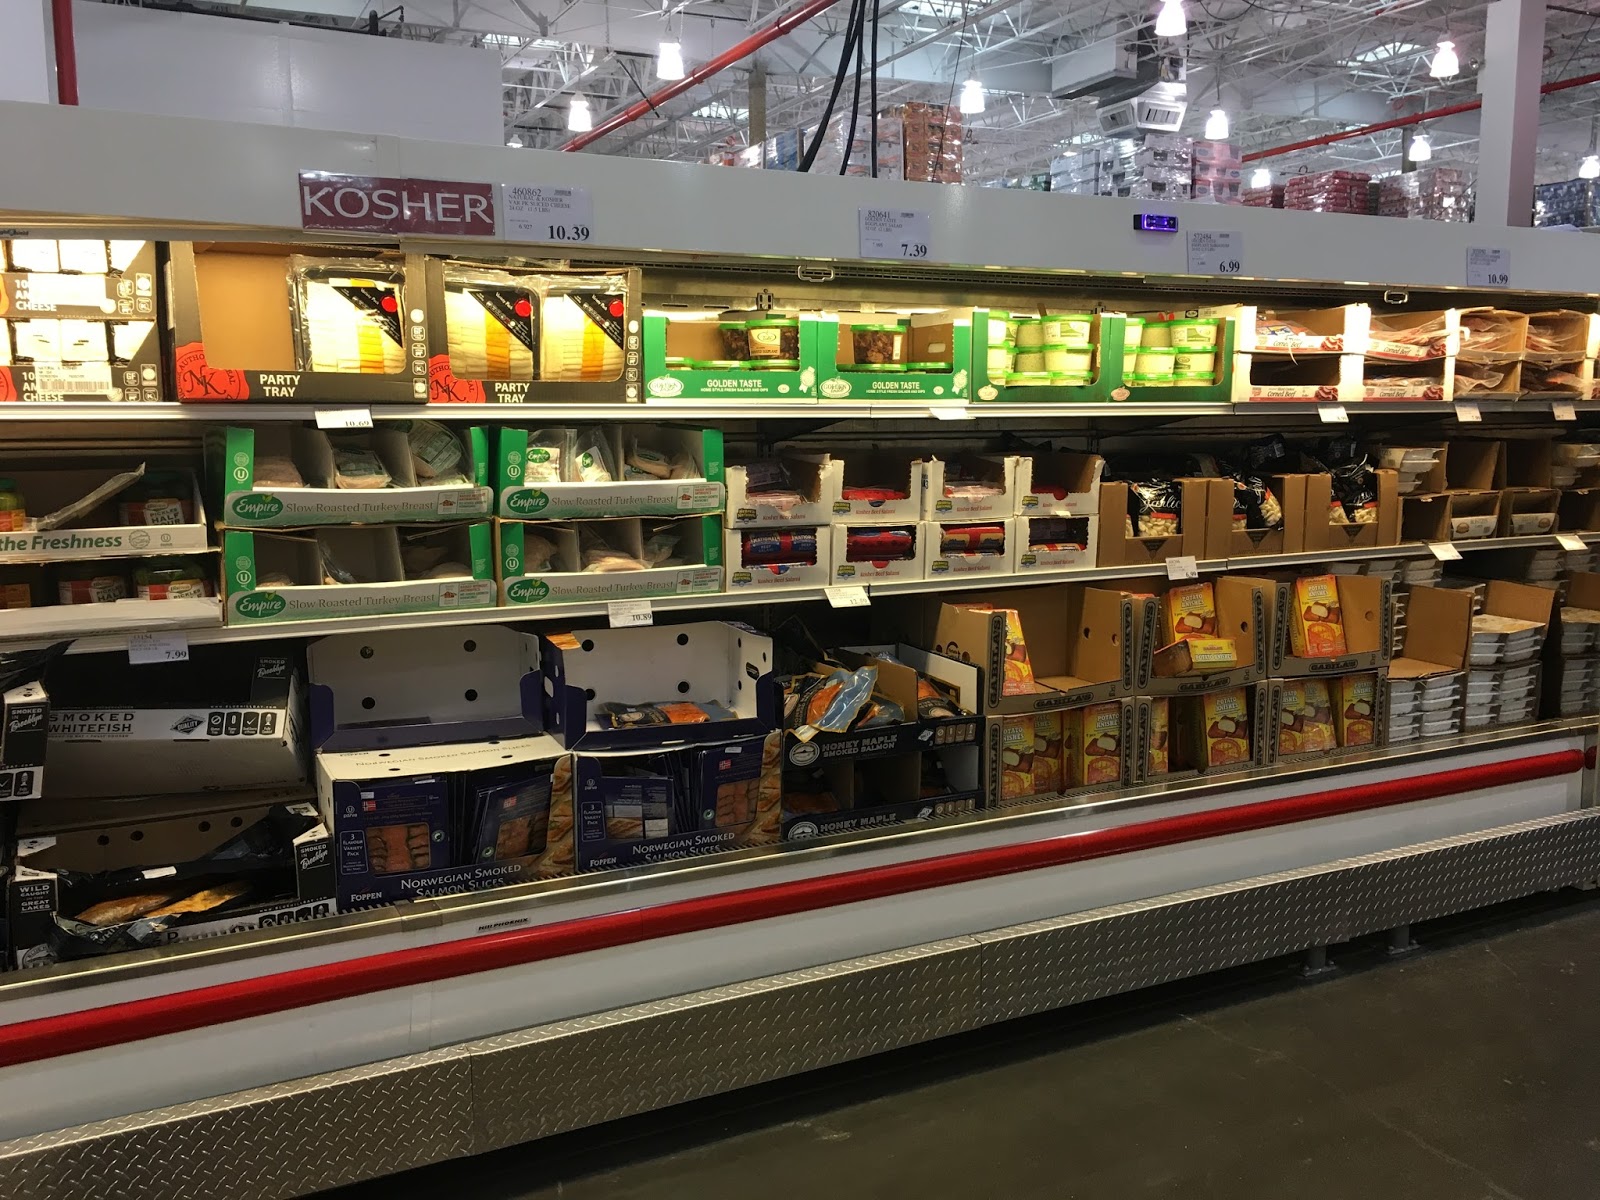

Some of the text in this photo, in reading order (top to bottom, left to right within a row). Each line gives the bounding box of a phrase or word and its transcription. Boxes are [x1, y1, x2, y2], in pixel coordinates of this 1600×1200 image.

[512, 187, 542, 197] 460862
[302, 185, 494, 225] KOSHER
[867, 210, 890, 219] 820641
[548, 225, 590, 241] 10.39
[901, 243, 928, 258] 7.39
[1219, 260, 1240, 273] 6.99
[1487, 273, 1509, 285] 10.99
[15, 301, 57, 312] CHEESE
[259, 374, 300, 385] PARTY
[707, 379, 762, 388] GOLDEN TASTE
[872, 381, 920, 389] GOLDEN TASTE
[263, 387, 296, 398] TRAY
[494, 382, 530, 393] PARTY
[23, 393, 64, 402] CHEESE
[497, 394, 526, 403] TRAY
[1285, 390, 1296, 398] Beef
[509, 495, 546, 512] Empire
[551, 495, 673, 507] Slow Roasted Turkey Breast
[1140, 495, 1181, 513] garlic
[149, 507, 178, 517] PICKLES
[236, 498, 279, 518] Empire
[286, 501, 434, 514] Slow Roasted Turkey Breast
[152, 512, 179, 522] HALF
[31, 534, 122, 550] Freshness
[173, 588, 201, 598] PICKLES
[510, 583, 546, 601] Empire
[551, 581, 674, 596] Slow Roasted Turkey Breast
[289, 593, 435, 609] Slow Roasted Turkey Breast
[1182, 593, 1203, 601] POTATO
[239, 597, 282, 617] Empire
[1181, 600, 1204, 608] KNISHES
[632, 613, 652, 621] 10.89
[165, 650, 187, 660] 7.99
[257, 664, 286, 678] Brooklyn
[1216, 697, 1237, 705] POTATO
[1215, 703, 1238, 712] KNISHES
[9, 713, 43, 732] Brooklyn
[49, 713, 135, 722] SMOKED
[1097, 713, 1120, 721] POTATO
[48, 723, 132, 733] WHITEFISH
[177, 720, 198, 731] QUALITY
[822, 734, 897, 752] HONEY MAPLE
[356, 743, 531, 767] NORWEGIAN SMOKED SALMON SLICES
[823, 742, 895, 758] SMOKED SALMON
[820, 813, 897, 833] HONEY MAPLE
[300, 844, 327, 853] SMOKED
[632, 832, 735, 855] NORWEGIAN SMOKED
[645, 844, 720, 861] SALMON SLICES
[300, 849, 328, 870] Brooklyn
[590, 857, 617, 867] FOPPEN
[400, 864, 522, 890] NORWEGIAN SMOKED
[19, 884, 50, 893] WILD
[416, 877, 504, 897] SALMON SLICES
[350, 891, 383, 902] FOPPEN
[493, 917, 529, 928] PHOENIX
